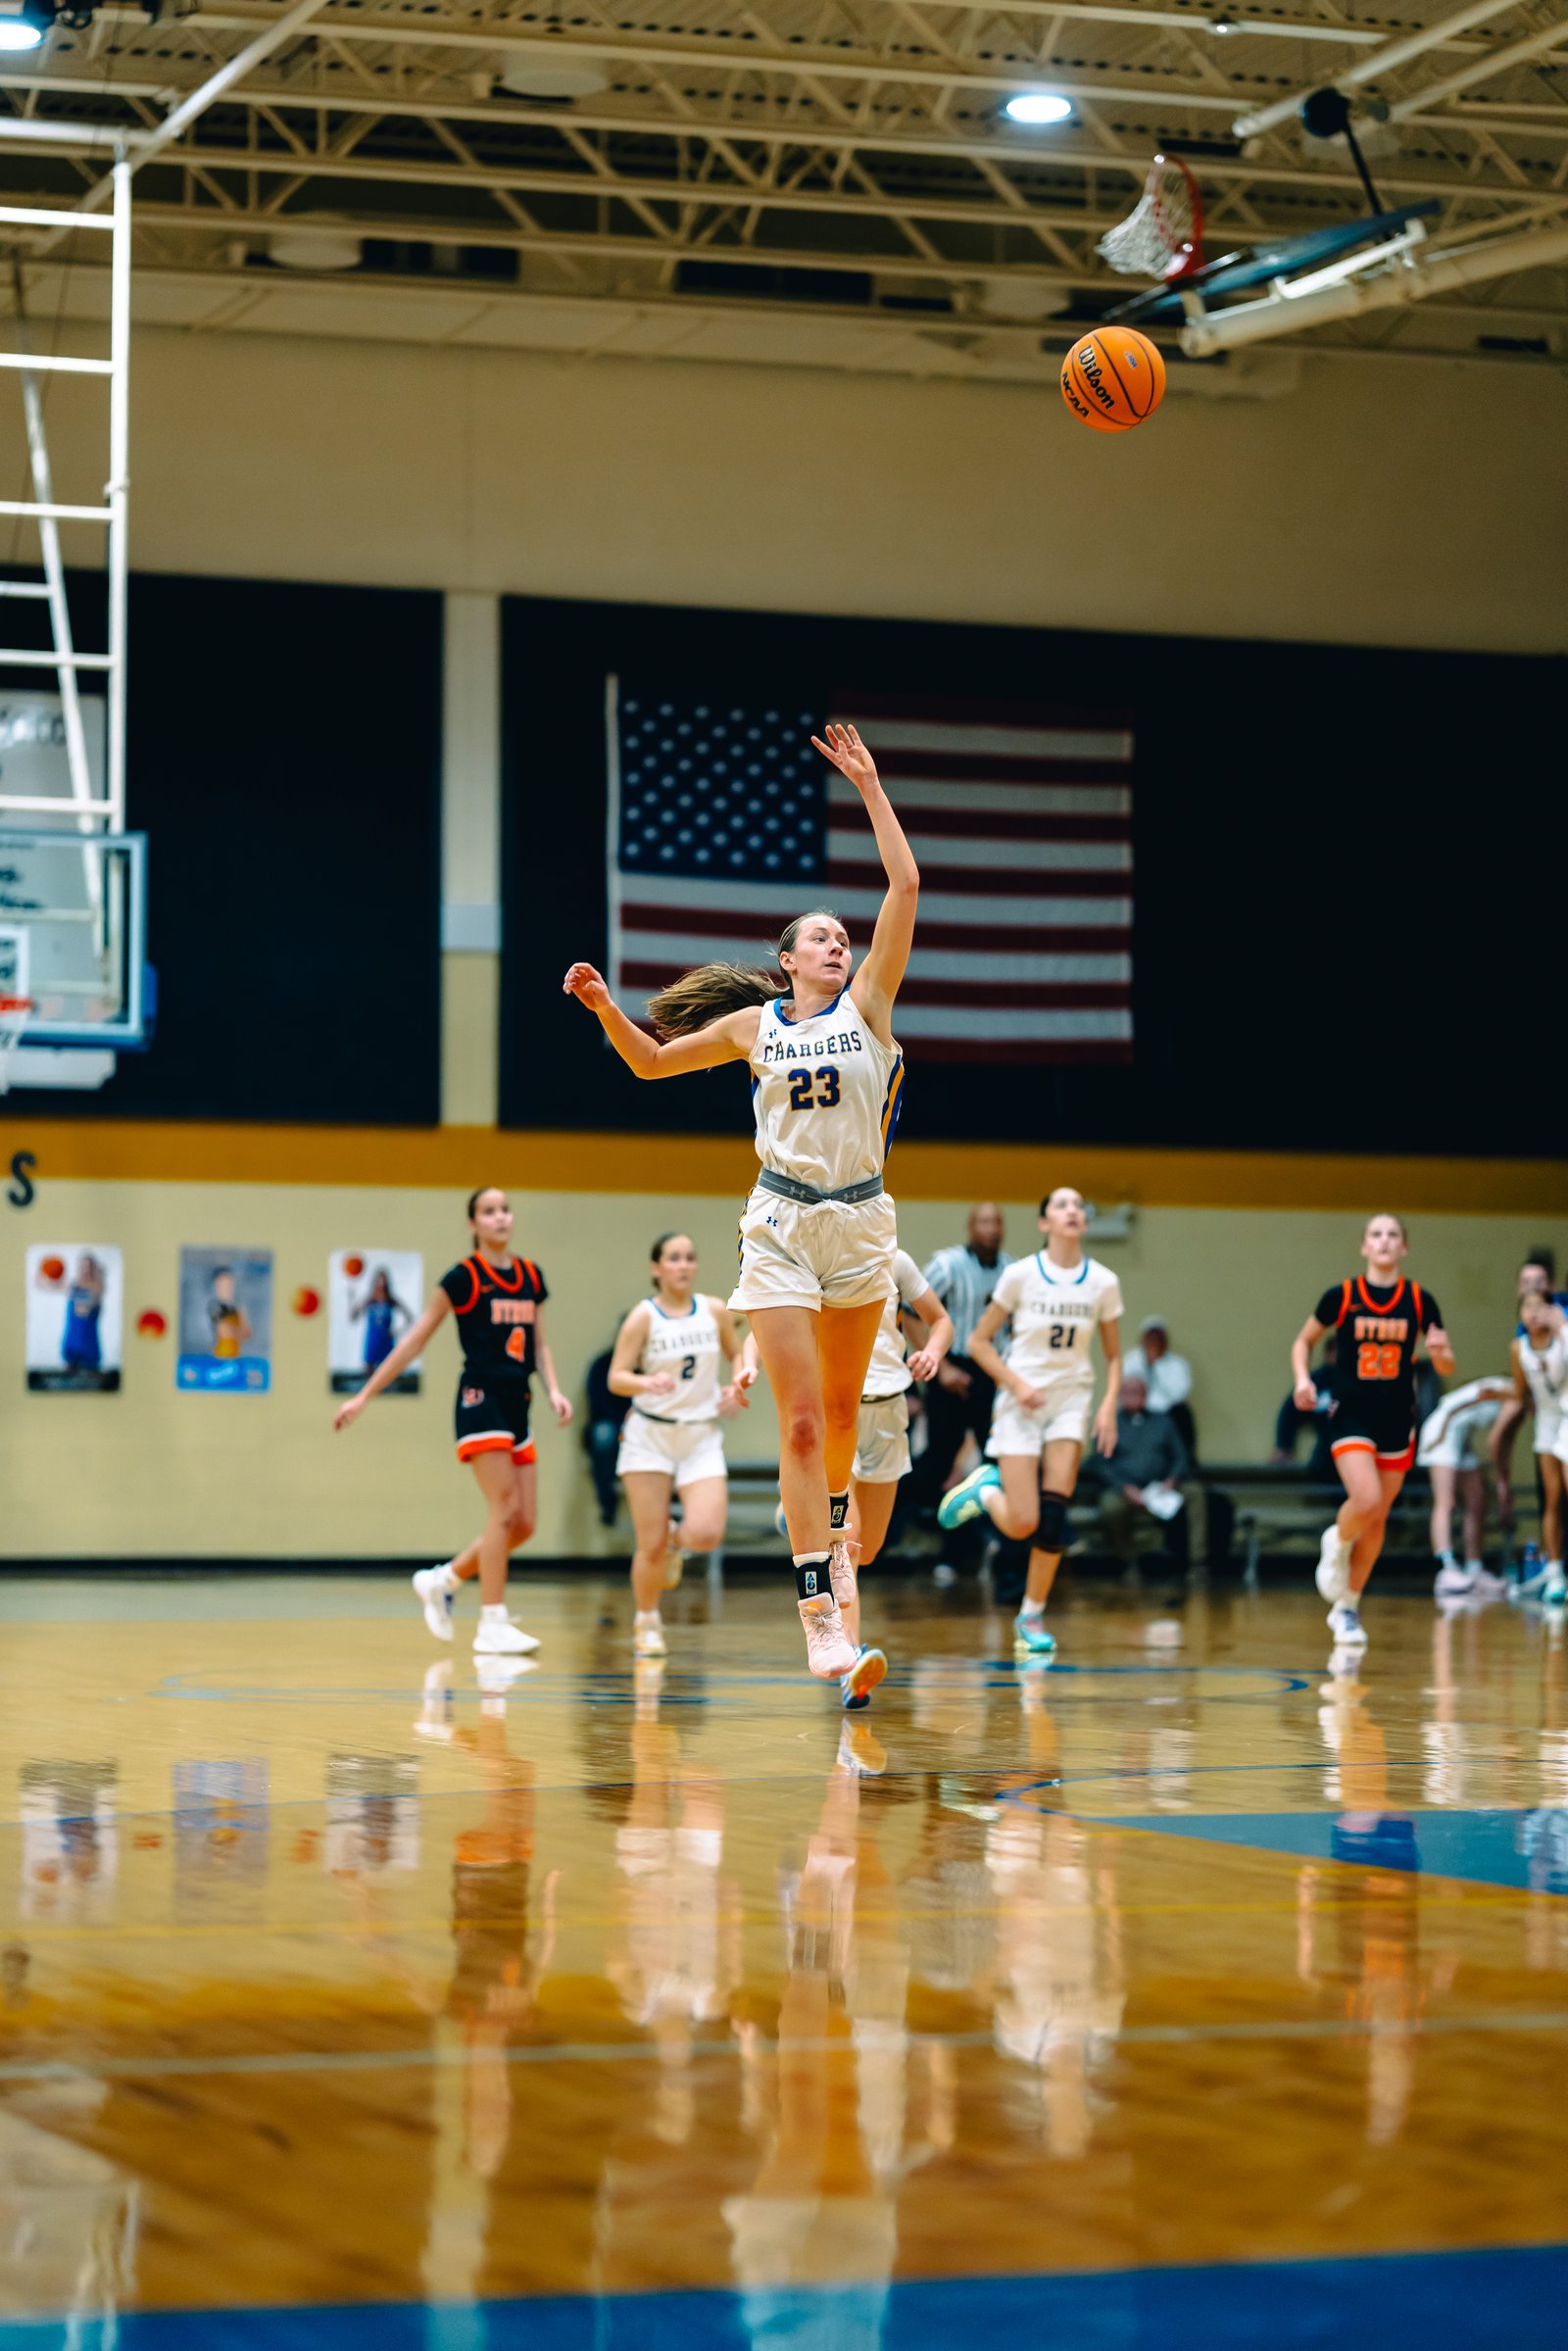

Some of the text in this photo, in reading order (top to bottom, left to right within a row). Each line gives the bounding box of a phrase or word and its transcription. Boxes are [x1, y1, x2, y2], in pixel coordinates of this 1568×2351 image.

[1061, 370, 1090, 418] NCAA
[1078, 344, 1115, 410] Wilson
[762, 1030, 862, 1063] CHARGERS
[787, 1065, 841, 1112] 23
[8, 1150, 36, 1208] S
[505, 1326, 525, 1363] 4
[1049, 1324, 1076, 1349] 21
[680, 1354, 697, 1380] 2
[1357, 1342, 1401, 1381] 22
